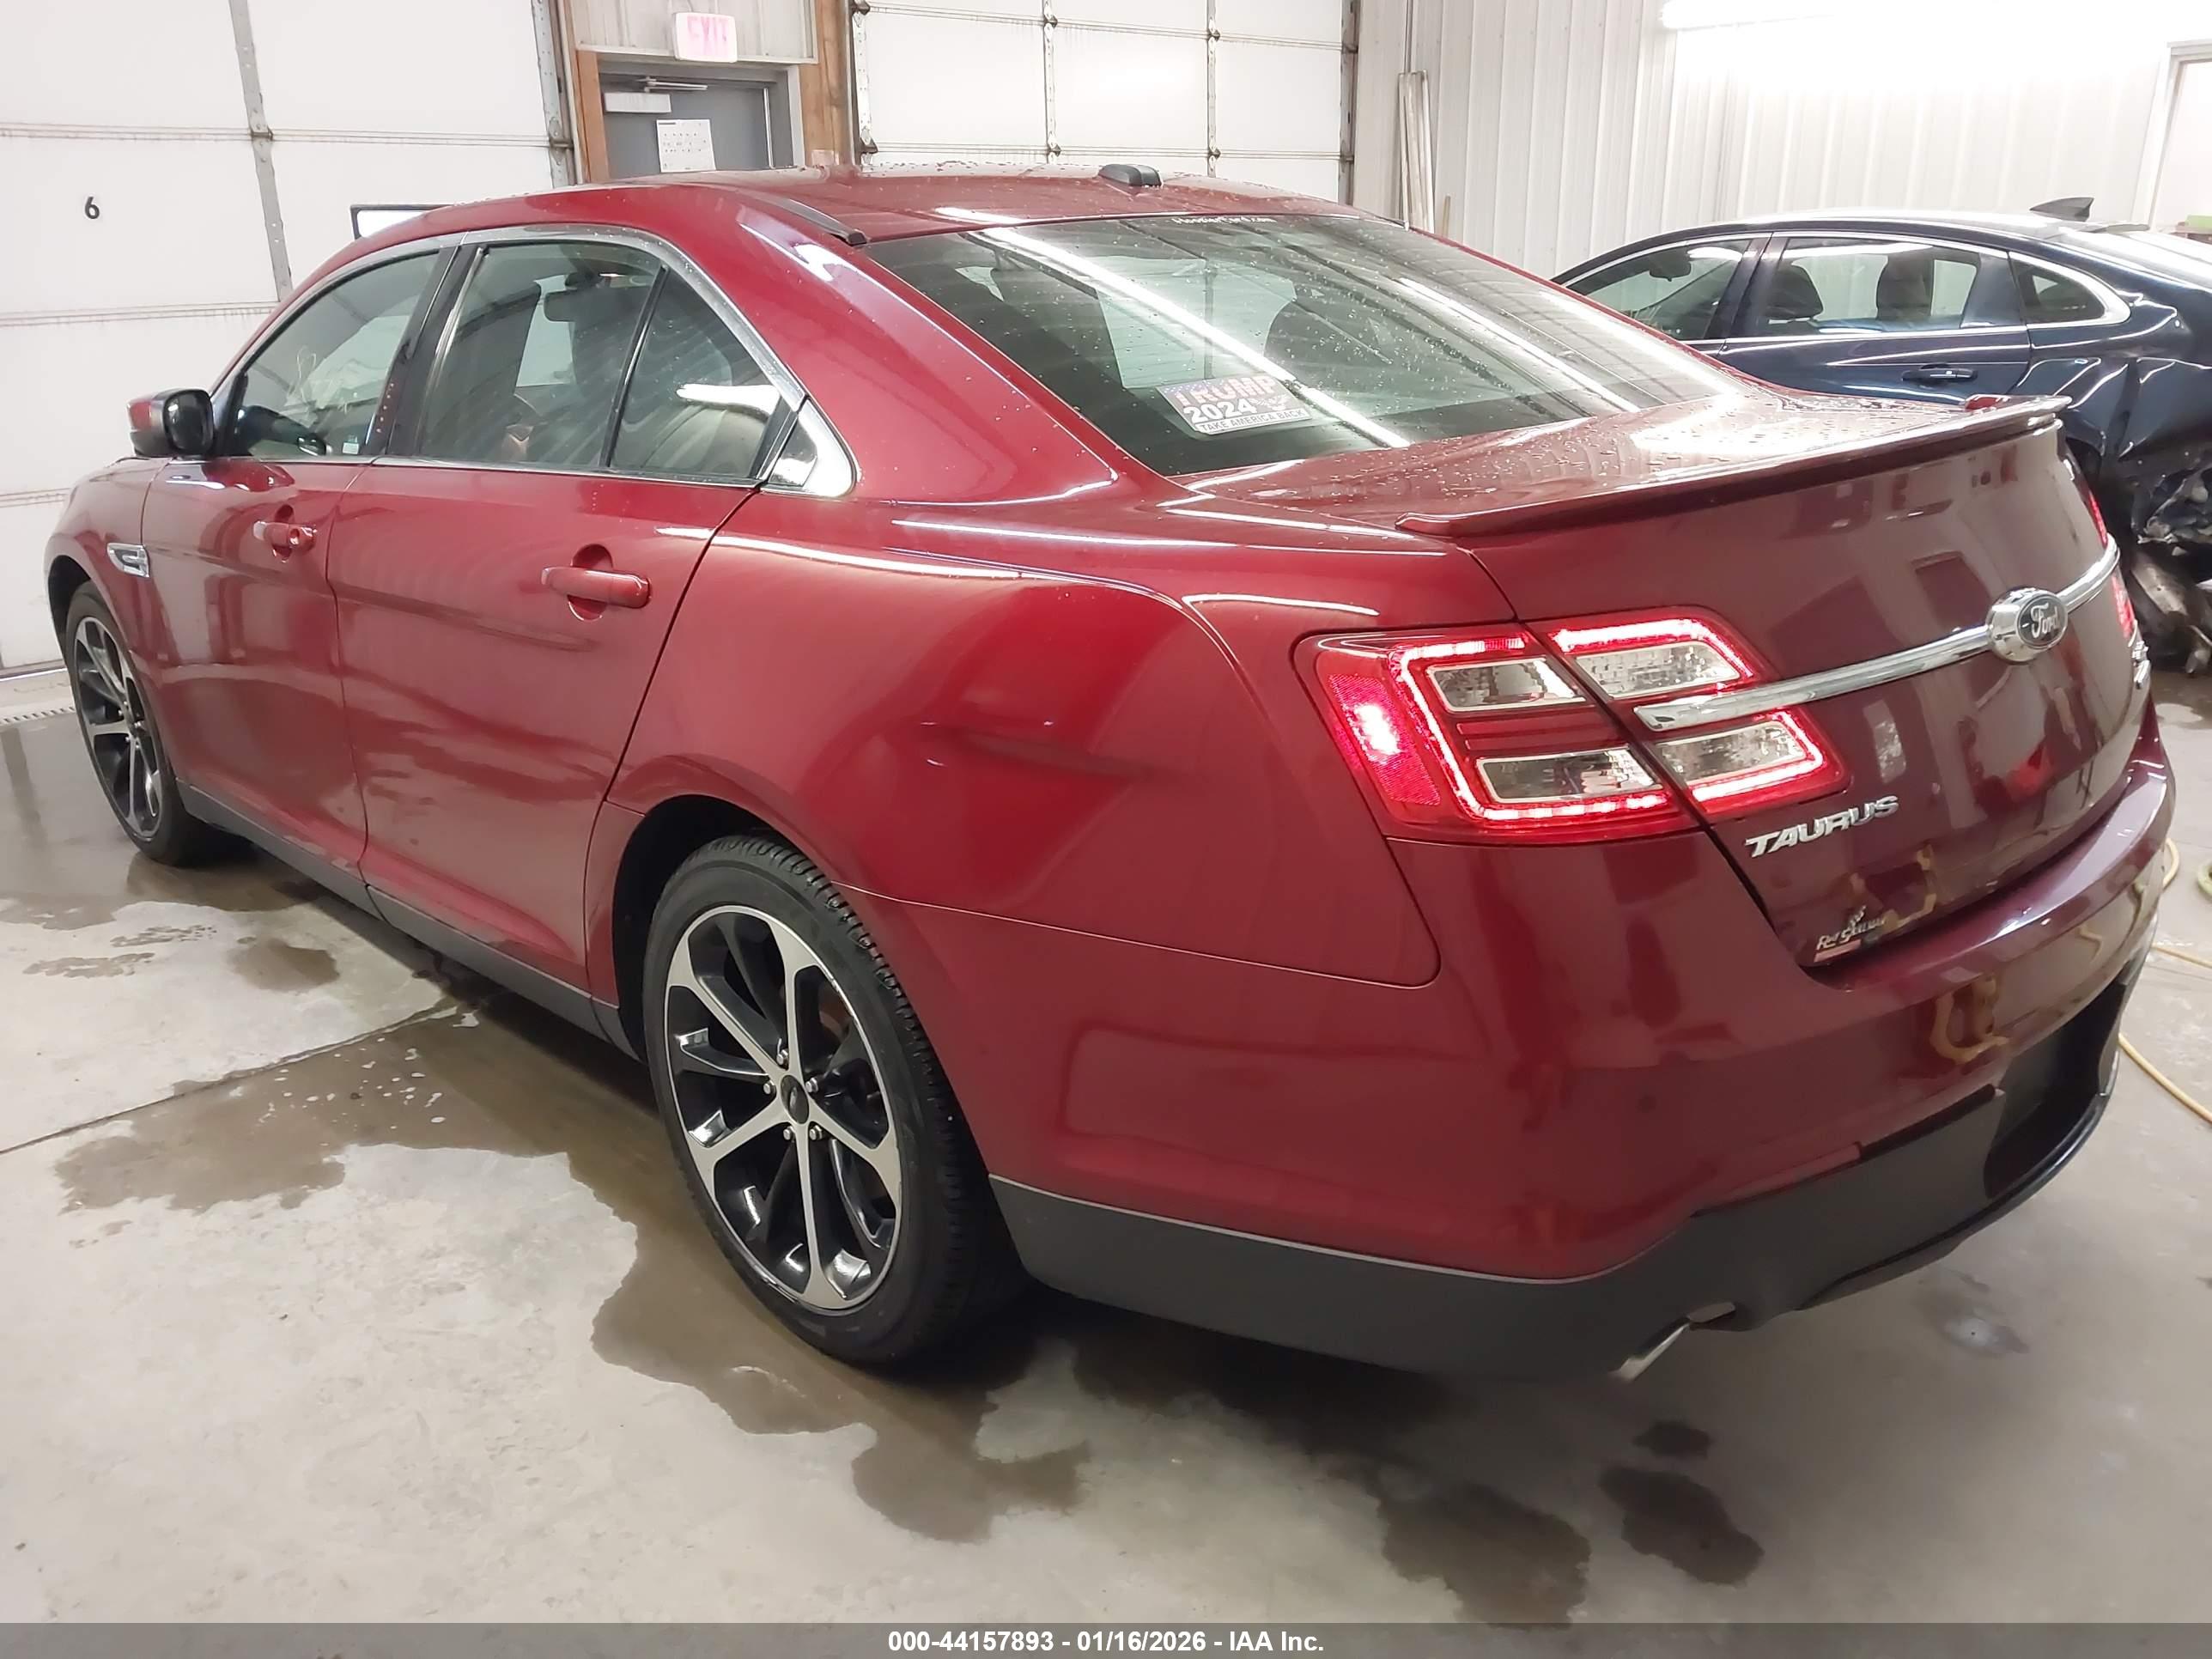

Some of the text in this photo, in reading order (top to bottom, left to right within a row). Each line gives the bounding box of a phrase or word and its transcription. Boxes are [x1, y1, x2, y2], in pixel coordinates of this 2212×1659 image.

[84, 197, 100, 220] 6
[1173, 375, 1276, 407] TRUMP
[1183, 398, 1258, 424] 2024
[1201, 408, 1303, 432] TAKE AMERICA BACK
[2030, 602, 2058, 639] Ford
[1744, 795, 1899, 858] TAURUS
